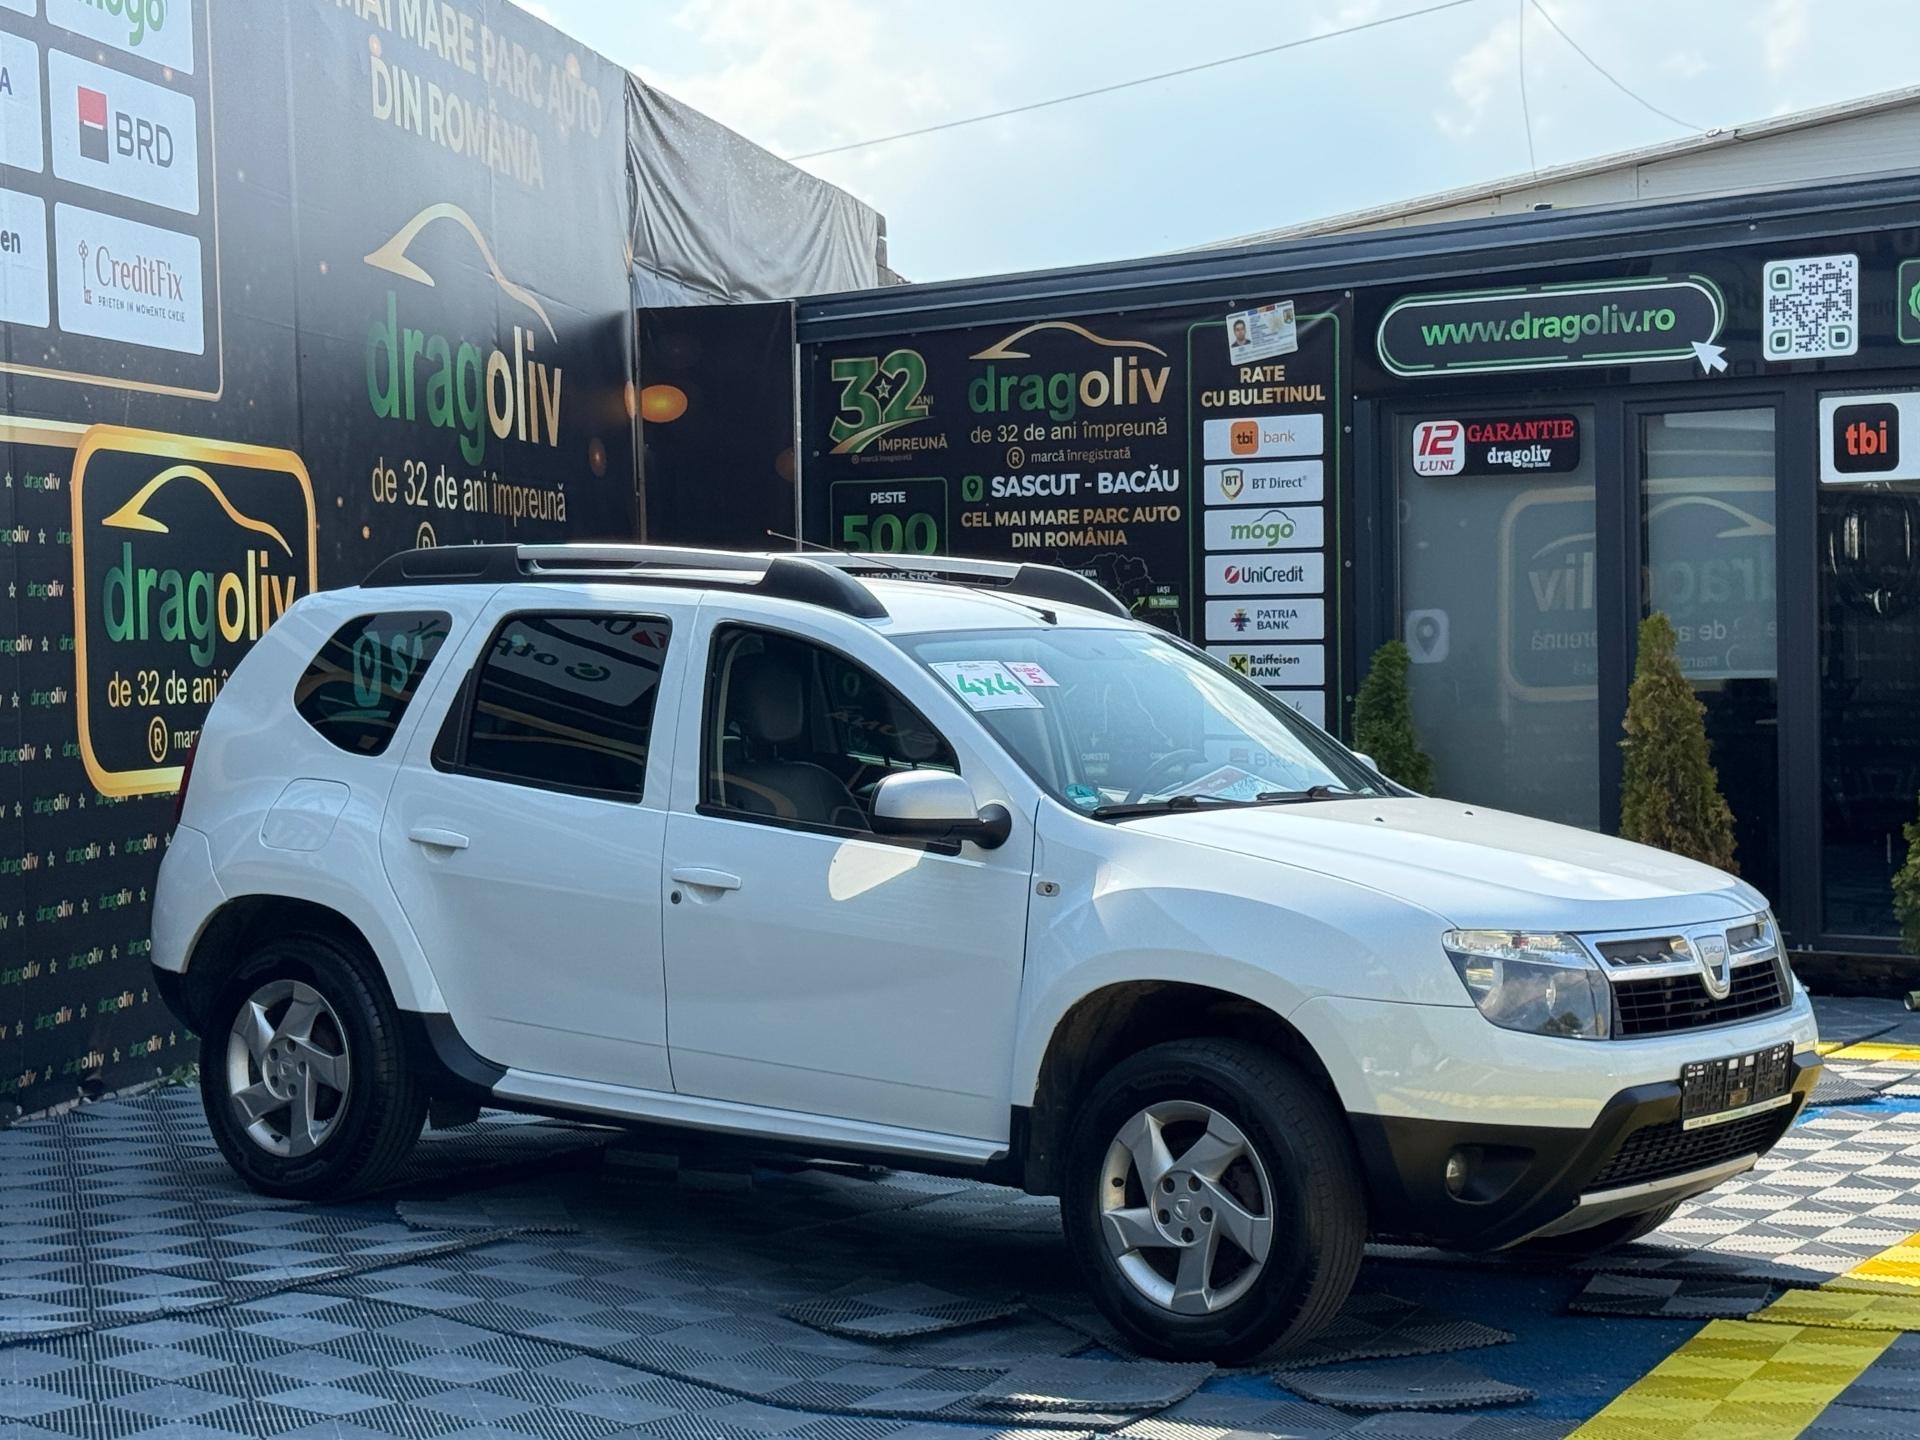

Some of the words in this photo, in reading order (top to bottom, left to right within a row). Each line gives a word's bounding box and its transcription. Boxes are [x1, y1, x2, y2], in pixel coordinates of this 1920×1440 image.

[400, 0, 476, 74] MARE
[480, 24, 543, 108] PARC
[549, 64, 600, 138] AUTO
[371, 56, 422, 136] DIN
[429, 82, 544, 189] ROMÂNIA
[115, 111, 173, 168] BRD
[96, 246, 183, 301] CreditFix
[98, 295, 124, 310] PRIETEN
[1421, 304, 1675, 346] www.dragoliv.ro
[366, 291, 562, 466] dragoliv
[1240, 365, 1285, 383] RATE
[829, 349, 926, 443] 32
[968, 356, 1171, 421] dragoliv
[1201, 390, 1224, 407] CU
[1229, 385, 1326, 406] BULETINUL
[916, 395, 934, 405] ANI
[970, 426, 991, 443] de
[998, 425, 1018, 442] 32
[1024, 423, 1045, 441] de
[1051, 421, 1076, 440] ani
[1083, 417, 1167, 441] împreună
[1236, 431, 1253, 444] tbi
[1263, 430, 1295, 443] bank
[1419, 424, 1459, 456] 12
[1467, 420, 1575, 442] GARANTIE
[1846, 421, 1887, 456] tbi
[878, 433, 948, 451] ÎMPREUNĂ
[1031, 449, 1065, 463] marcă
[1067, 447, 1131, 464] înregistrată
[1419, 459, 1455, 472] LUNI
[1487, 444, 1552, 468] dragoliv
[24, 473, 61, 493] dragoliv
[372, 457, 397, 503] de
[404, 459, 428, 506] 32
[434, 465, 457, 510] de
[464, 471, 487, 513] ani
[492, 472, 566, 527] împreună
[991, 474, 1080, 498] SASCUT
[1098, 464, 1179, 494] BACĂU
[1225, 475, 1239, 486] BT
[1252, 478, 1267, 489] BT
[870, 491, 906, 504] PESTE
[961, 512, 991, 527] CEL
[995, 511, 1026, 527] MAI
[1030, 509, 1079, 526] MARE
[1083, 507, 1129, 524] PARC
[1133, 505, 1181, 523] AUTO
[0, 525, 30, 546] ragoliv
[843, 512, 938, 555] 500
[1012, 533, 1041, 548] DIN
[1045, 527, 1127, 547] ROMÂNIA
[1231, 523, 1294, 547] mogo
[1242, 566, 1304, 583] UniCredit
[27, 580, 64, 600] dragoliv
[1256, 609, 1298, 619] PATRIA
[1257, 620, 1289, 630] BANK
[0, 635, 33, 656] ragoliv
[1250, 654, 1300, 665] Raiffeisen
[1026, 673, 1045, 684] 5
[1250, 667, 1281, 678] BANK
[108, 671, 132, 707] de
[137, 670, 160, 706] 32
[165, 669, 187, 705] de
[193, 670, 218, 703] ani
[957, 673, 1023, 696] 4x4
[30, 687, 67, 708] dragoliv
[33, 793, 70, 815] dragoliv
[65, 842, 101, 865] dragoliv
[125, 833, 158, 854] dragoliv
[35, 900, 74, 923] dragoliv
[99, 887, 133, 911] dragoliv
[1, 962, 41, 986] dragoliv
[35, 1006, 73, 1030] dragoliv
[97, 991, 135, 1015] dragoliv
